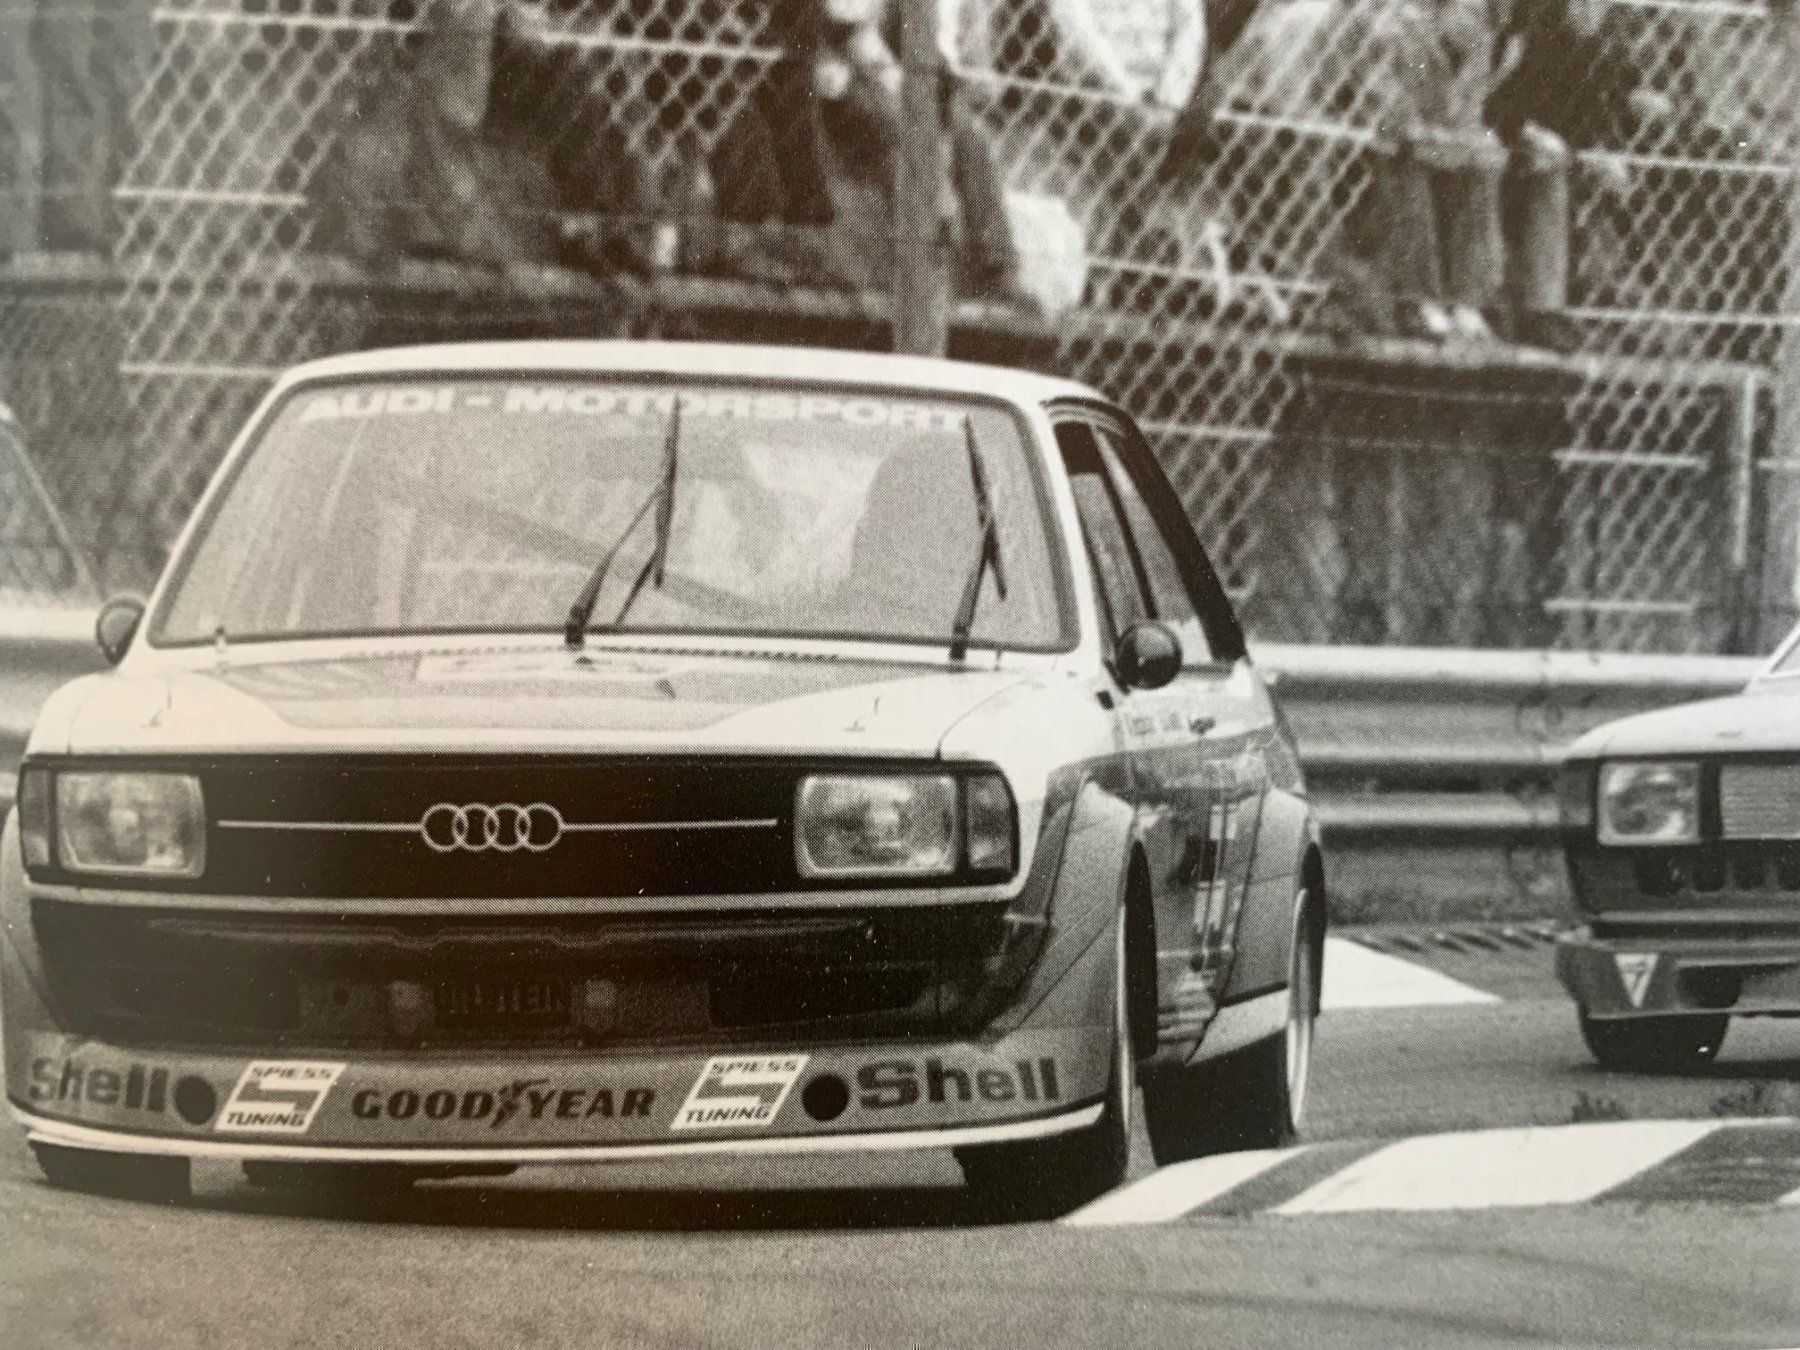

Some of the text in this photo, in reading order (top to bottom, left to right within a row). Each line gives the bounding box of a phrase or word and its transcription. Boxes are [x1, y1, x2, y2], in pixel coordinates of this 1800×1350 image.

[298, 387, 455, 423] AUDI
[711, 1061, 798, 1074] SPIESS
[30, 1056, 169, 1113] Shell
[857, 1056, 1061, 1110] Shell
[226, 1111, 306, 1127] TUNING
[686, 1106, 770, 1124] TUNING
